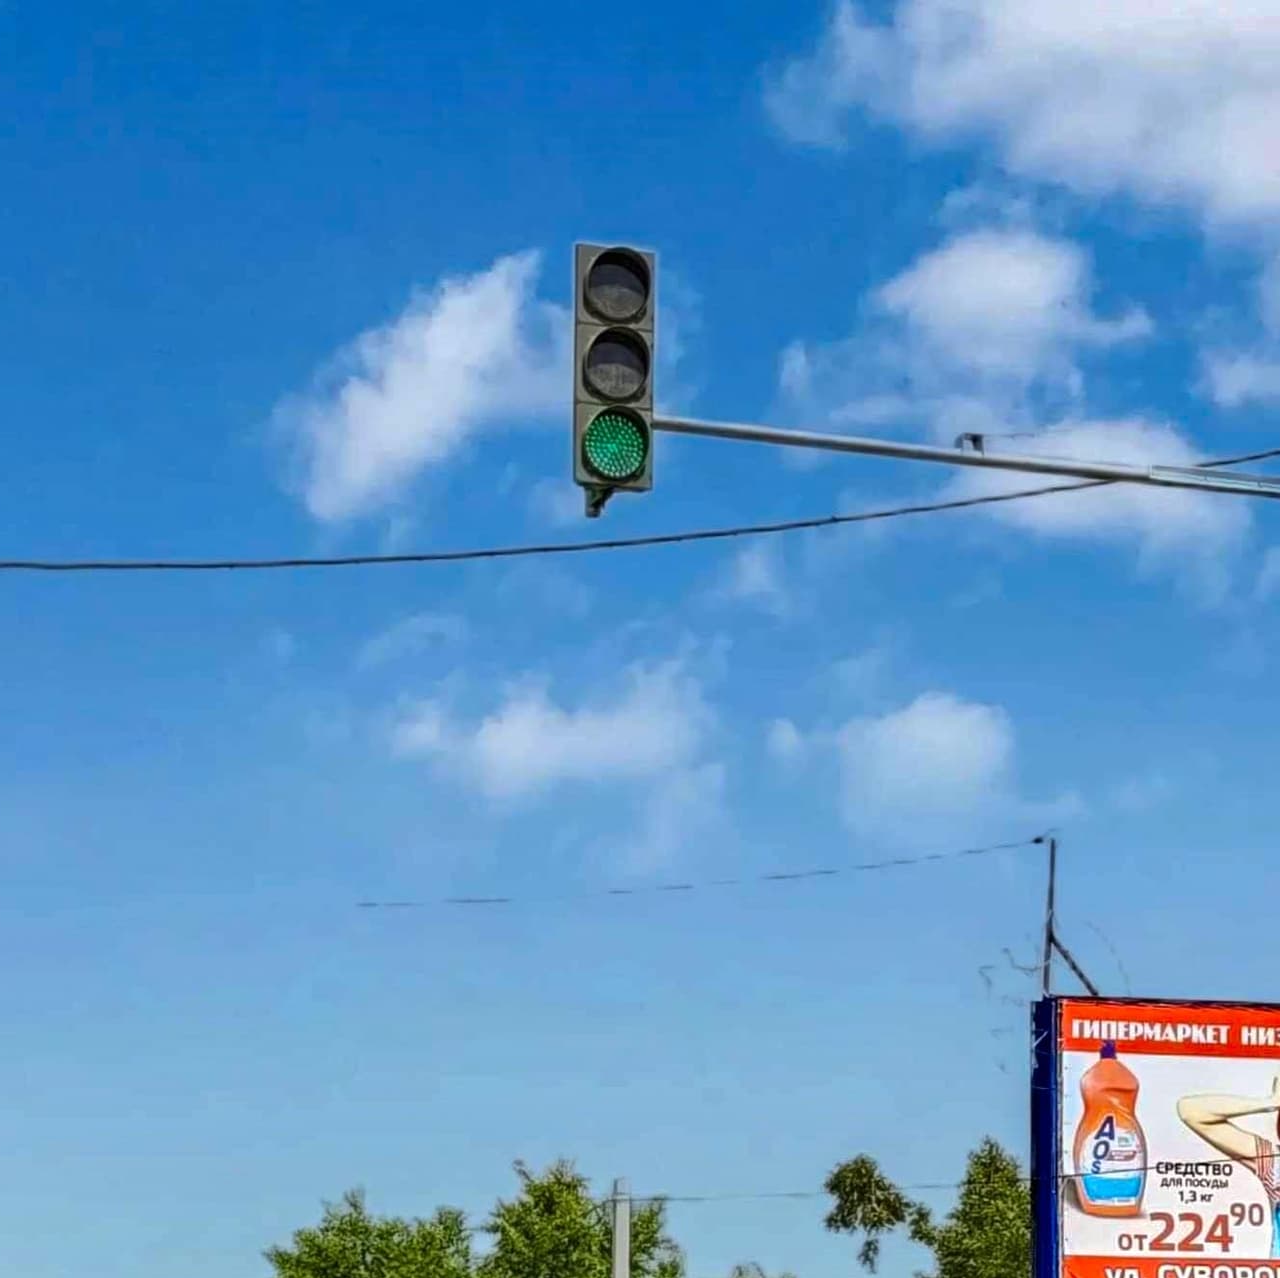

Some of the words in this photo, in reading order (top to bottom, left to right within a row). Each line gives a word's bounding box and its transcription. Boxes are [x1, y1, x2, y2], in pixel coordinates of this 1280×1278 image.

[1072, 1018, 1230, 1045] ГИПЕРМАРКЕТ
[1156, 1161, 1233, 1177] СРЕДСТВО
[1178, 1190, 1197, 1204] 1,3
[1200, 1192, 1214, 1203] кг
